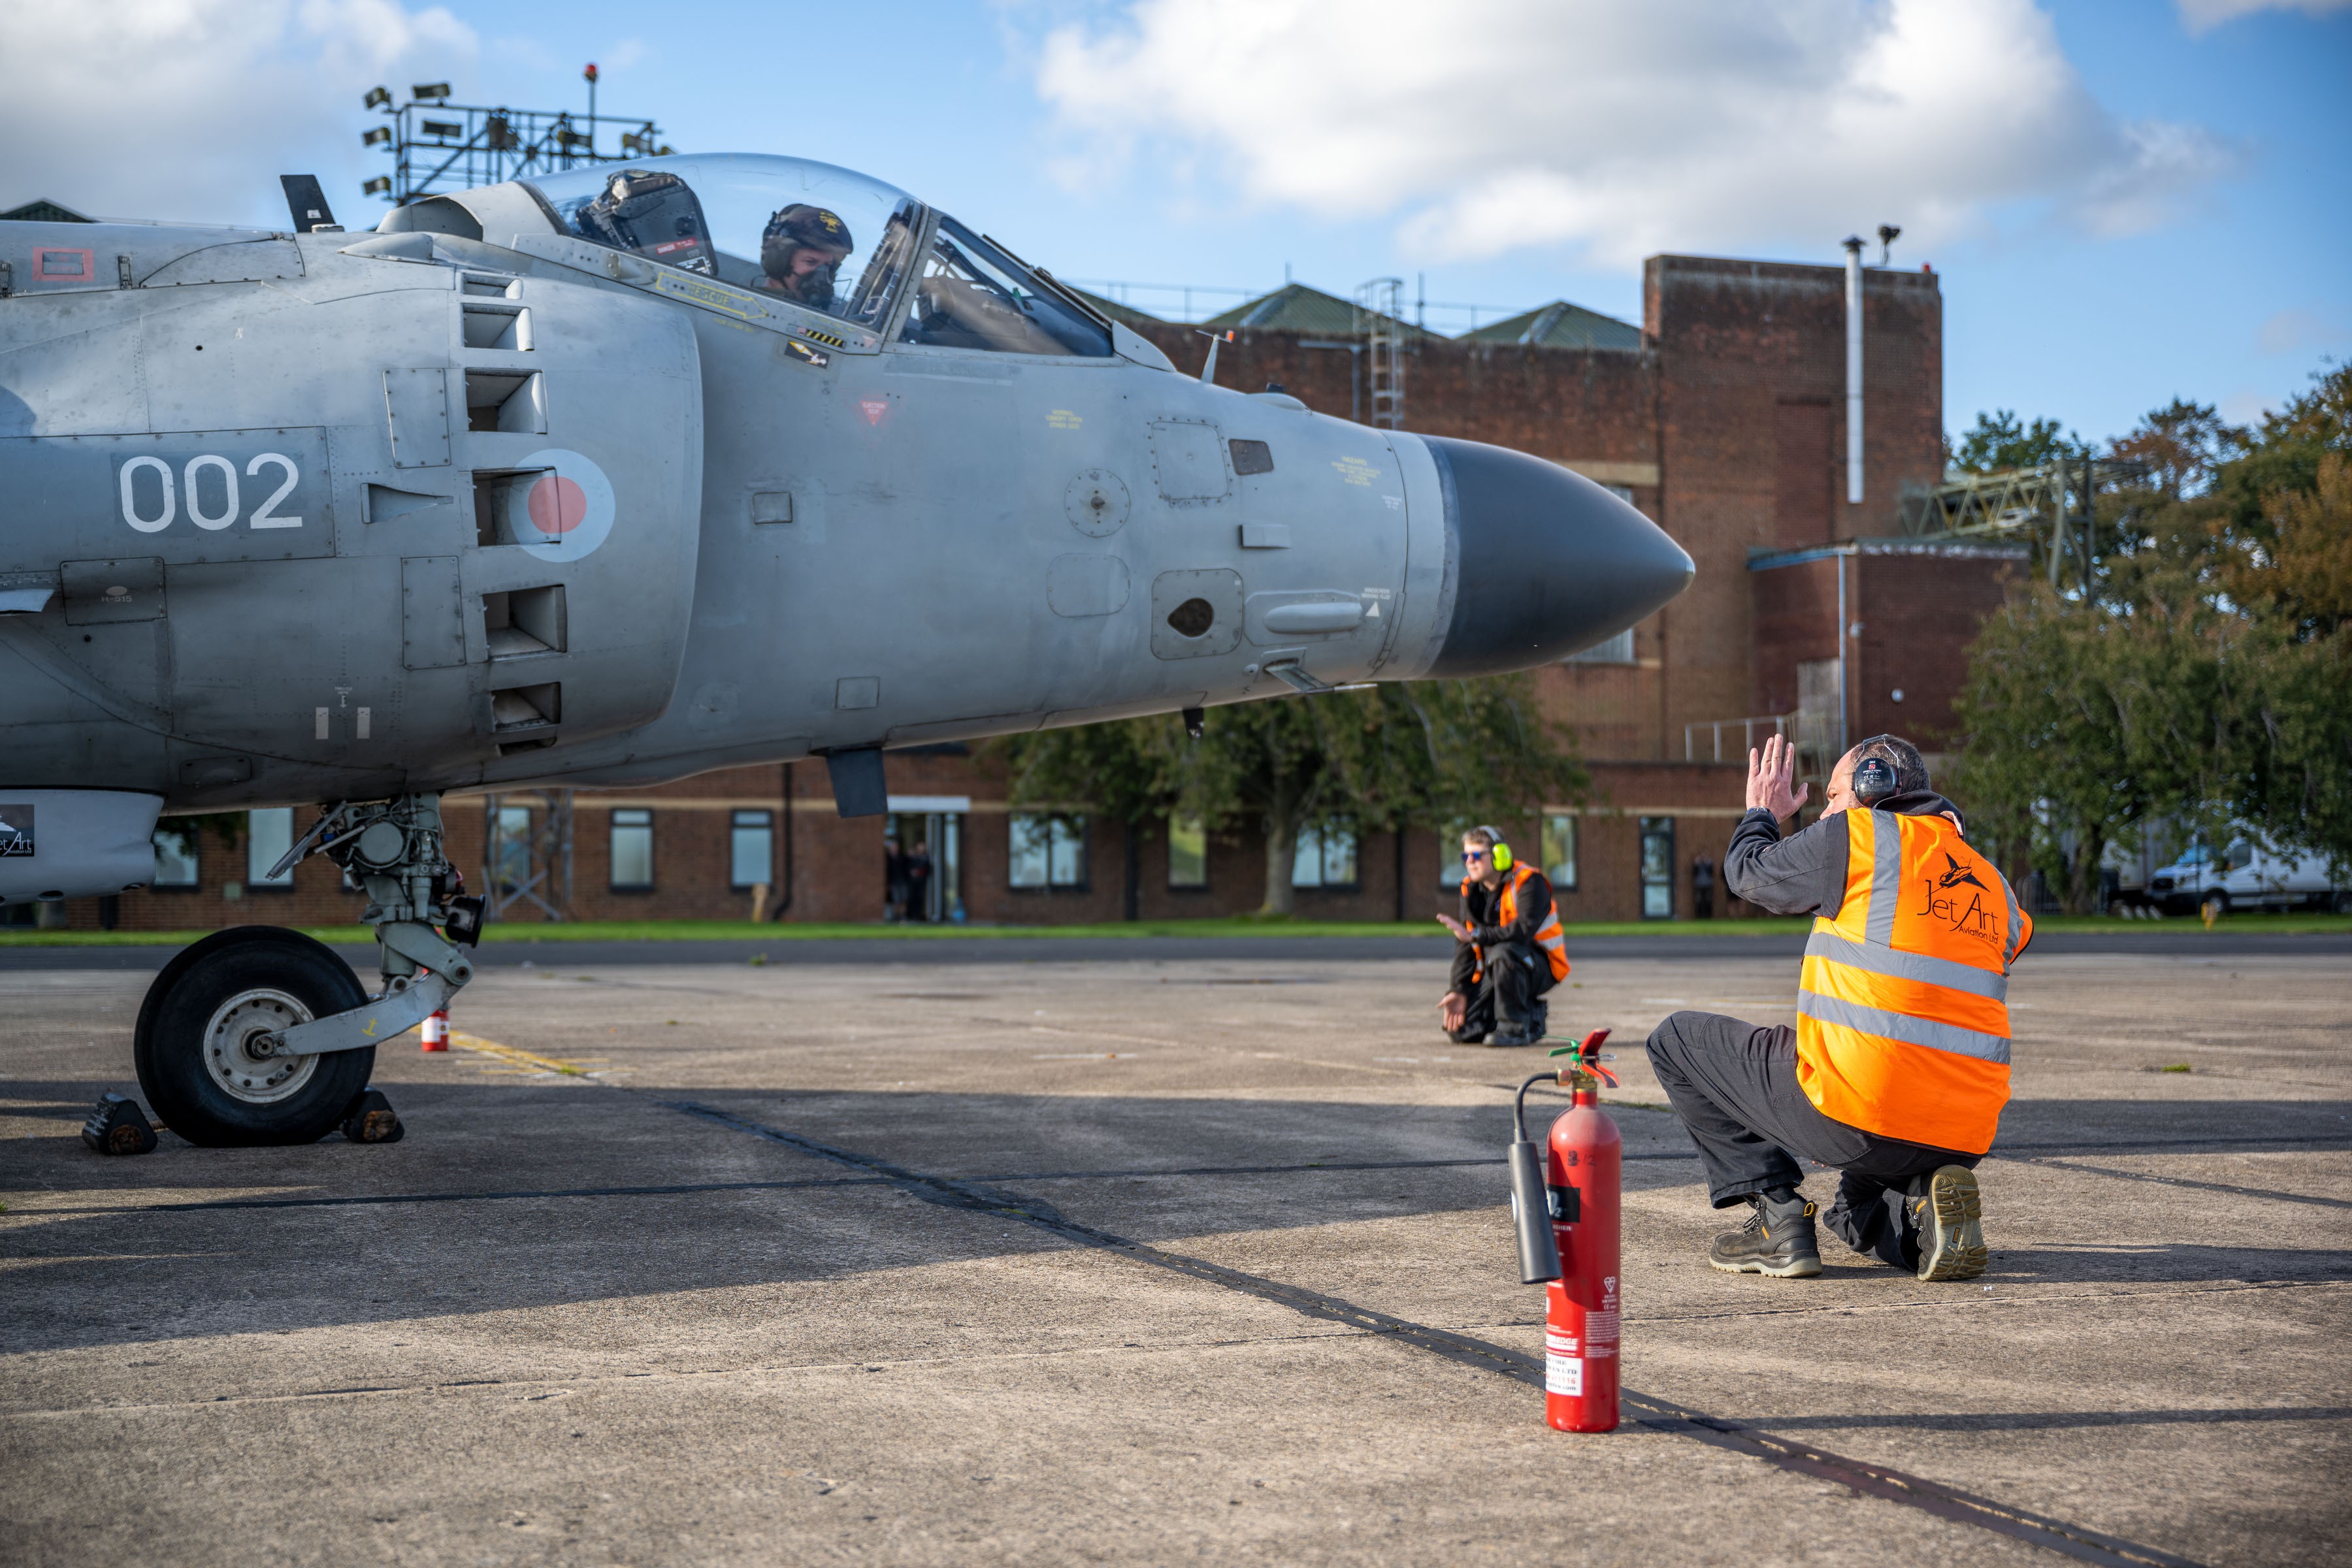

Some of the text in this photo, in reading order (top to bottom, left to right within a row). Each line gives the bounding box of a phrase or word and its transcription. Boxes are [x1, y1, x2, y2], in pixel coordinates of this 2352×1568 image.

[687, 284, 730, 306] RESCUE
[120, 452, 302, 533] 002
[2, 832, 32, 857] Art
[1917, 879, 1999, 936] Jet Art
[1958, 925, 1999, 945] Aviation Ltd
